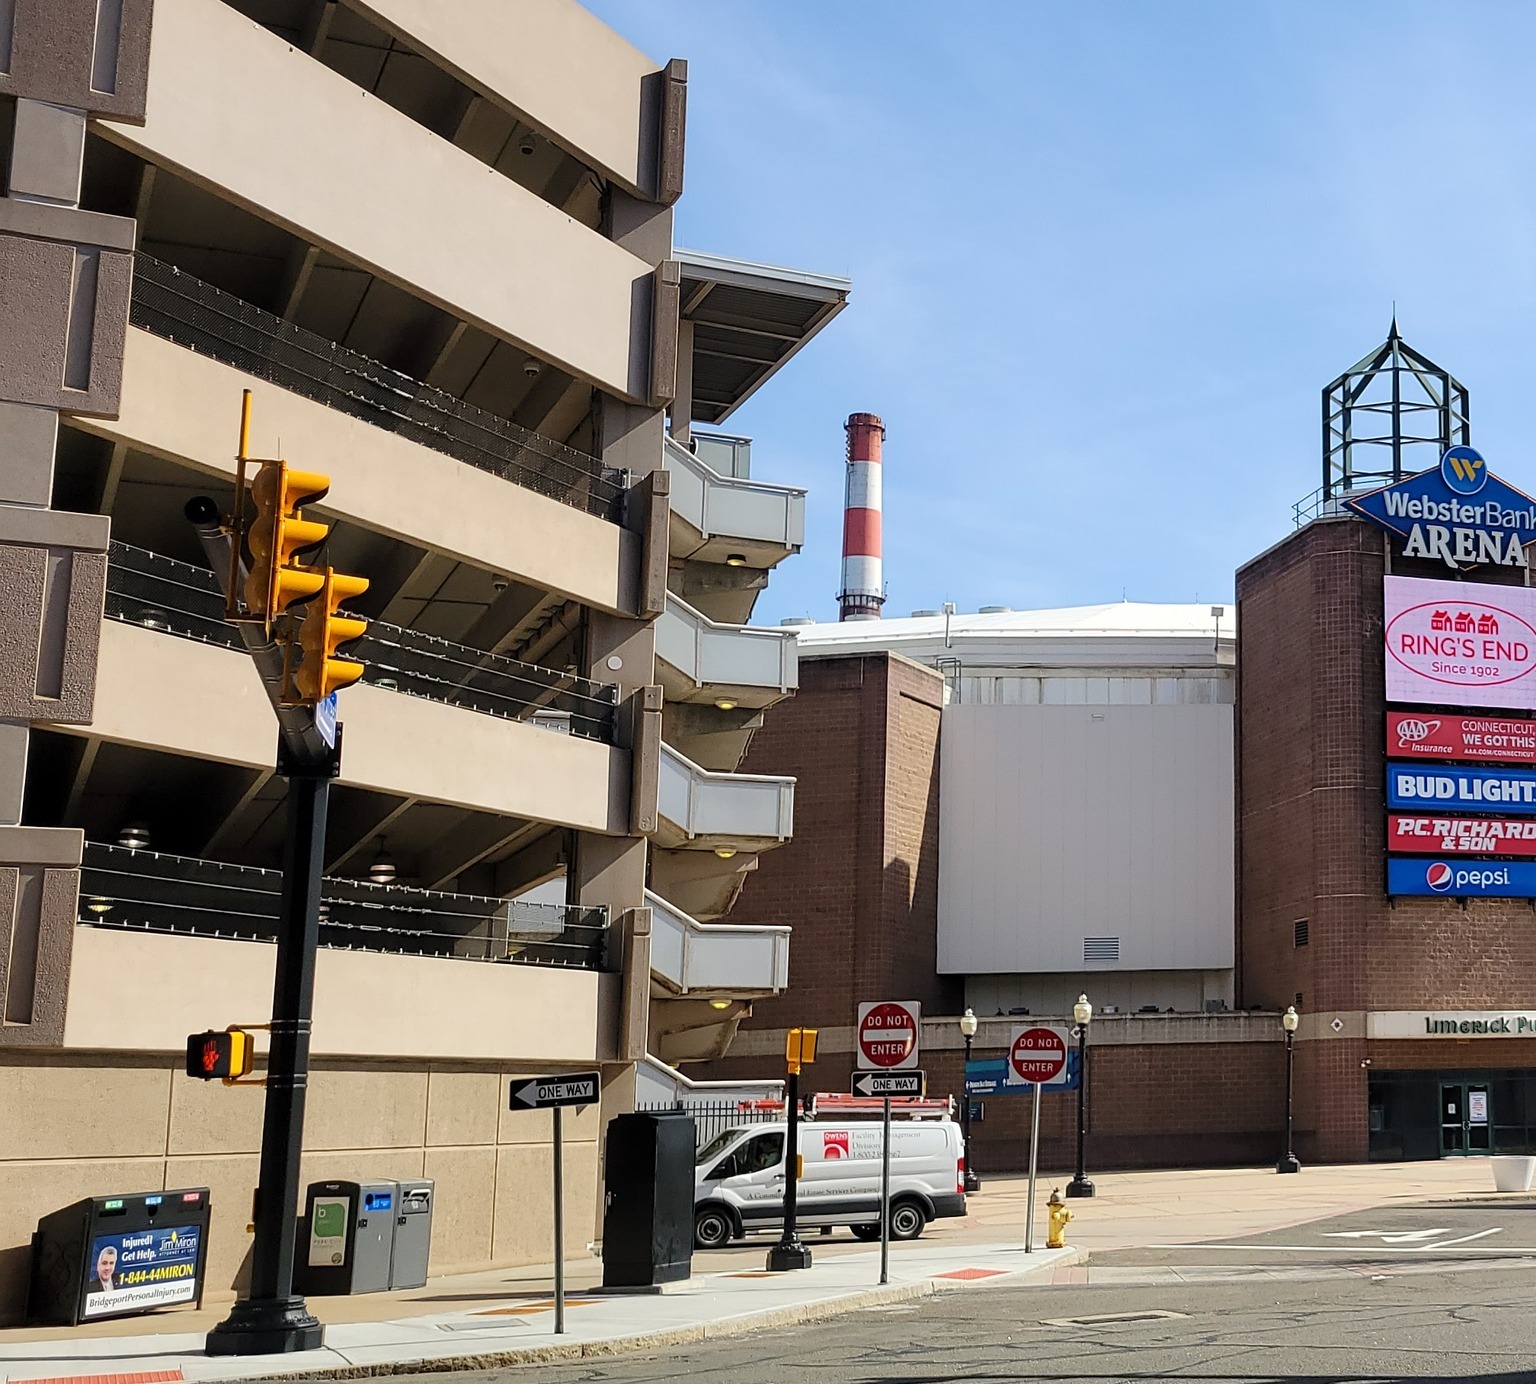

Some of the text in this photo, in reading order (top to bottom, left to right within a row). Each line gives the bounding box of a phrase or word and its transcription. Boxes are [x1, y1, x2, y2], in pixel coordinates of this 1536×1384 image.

[1402, 523, 1528, 568] ARENA
[1401, 634, 1528, 662] RING'S END
[1431, 661, 1500, 677] Since 1902
[1399, 722, 1426, 737] AAA
[1461, 720, 1536, 735] CONNECTICUT,
[1411, 742, 1453, 753] Insurance
[1462, 734, 1535, 748] WE GOT THIS
[1397, 775, 1536, 802] BUD LIGHT
[1441, 836, 1497, 851] & SON
[1456, 867, 1509, 889] pepsi
[867, 1015, 908, 1026] DO NOT
[871, 1044, 904, 1055] ENTER
[1020, 1038, 1059, 1047] DO NOT
[1022, 1063, 1053, 1072] ENTER
[873, 1078, 915, 1089] ONE WAY
[538, 1083, 589, 1099] ONE WAY
[824, 1132, 848, 1140] OWENS
[122, 1235, 153, 1249] Injured?
[159, 1237, 197, 1250] Jim Miron
[121, 1248, 157, 1261] Get Help.
[119, 1263, 194, 1285] 1-844-44MIRON
[88, 1285, 191, 1308] BridgeportPersonalInjury.com
